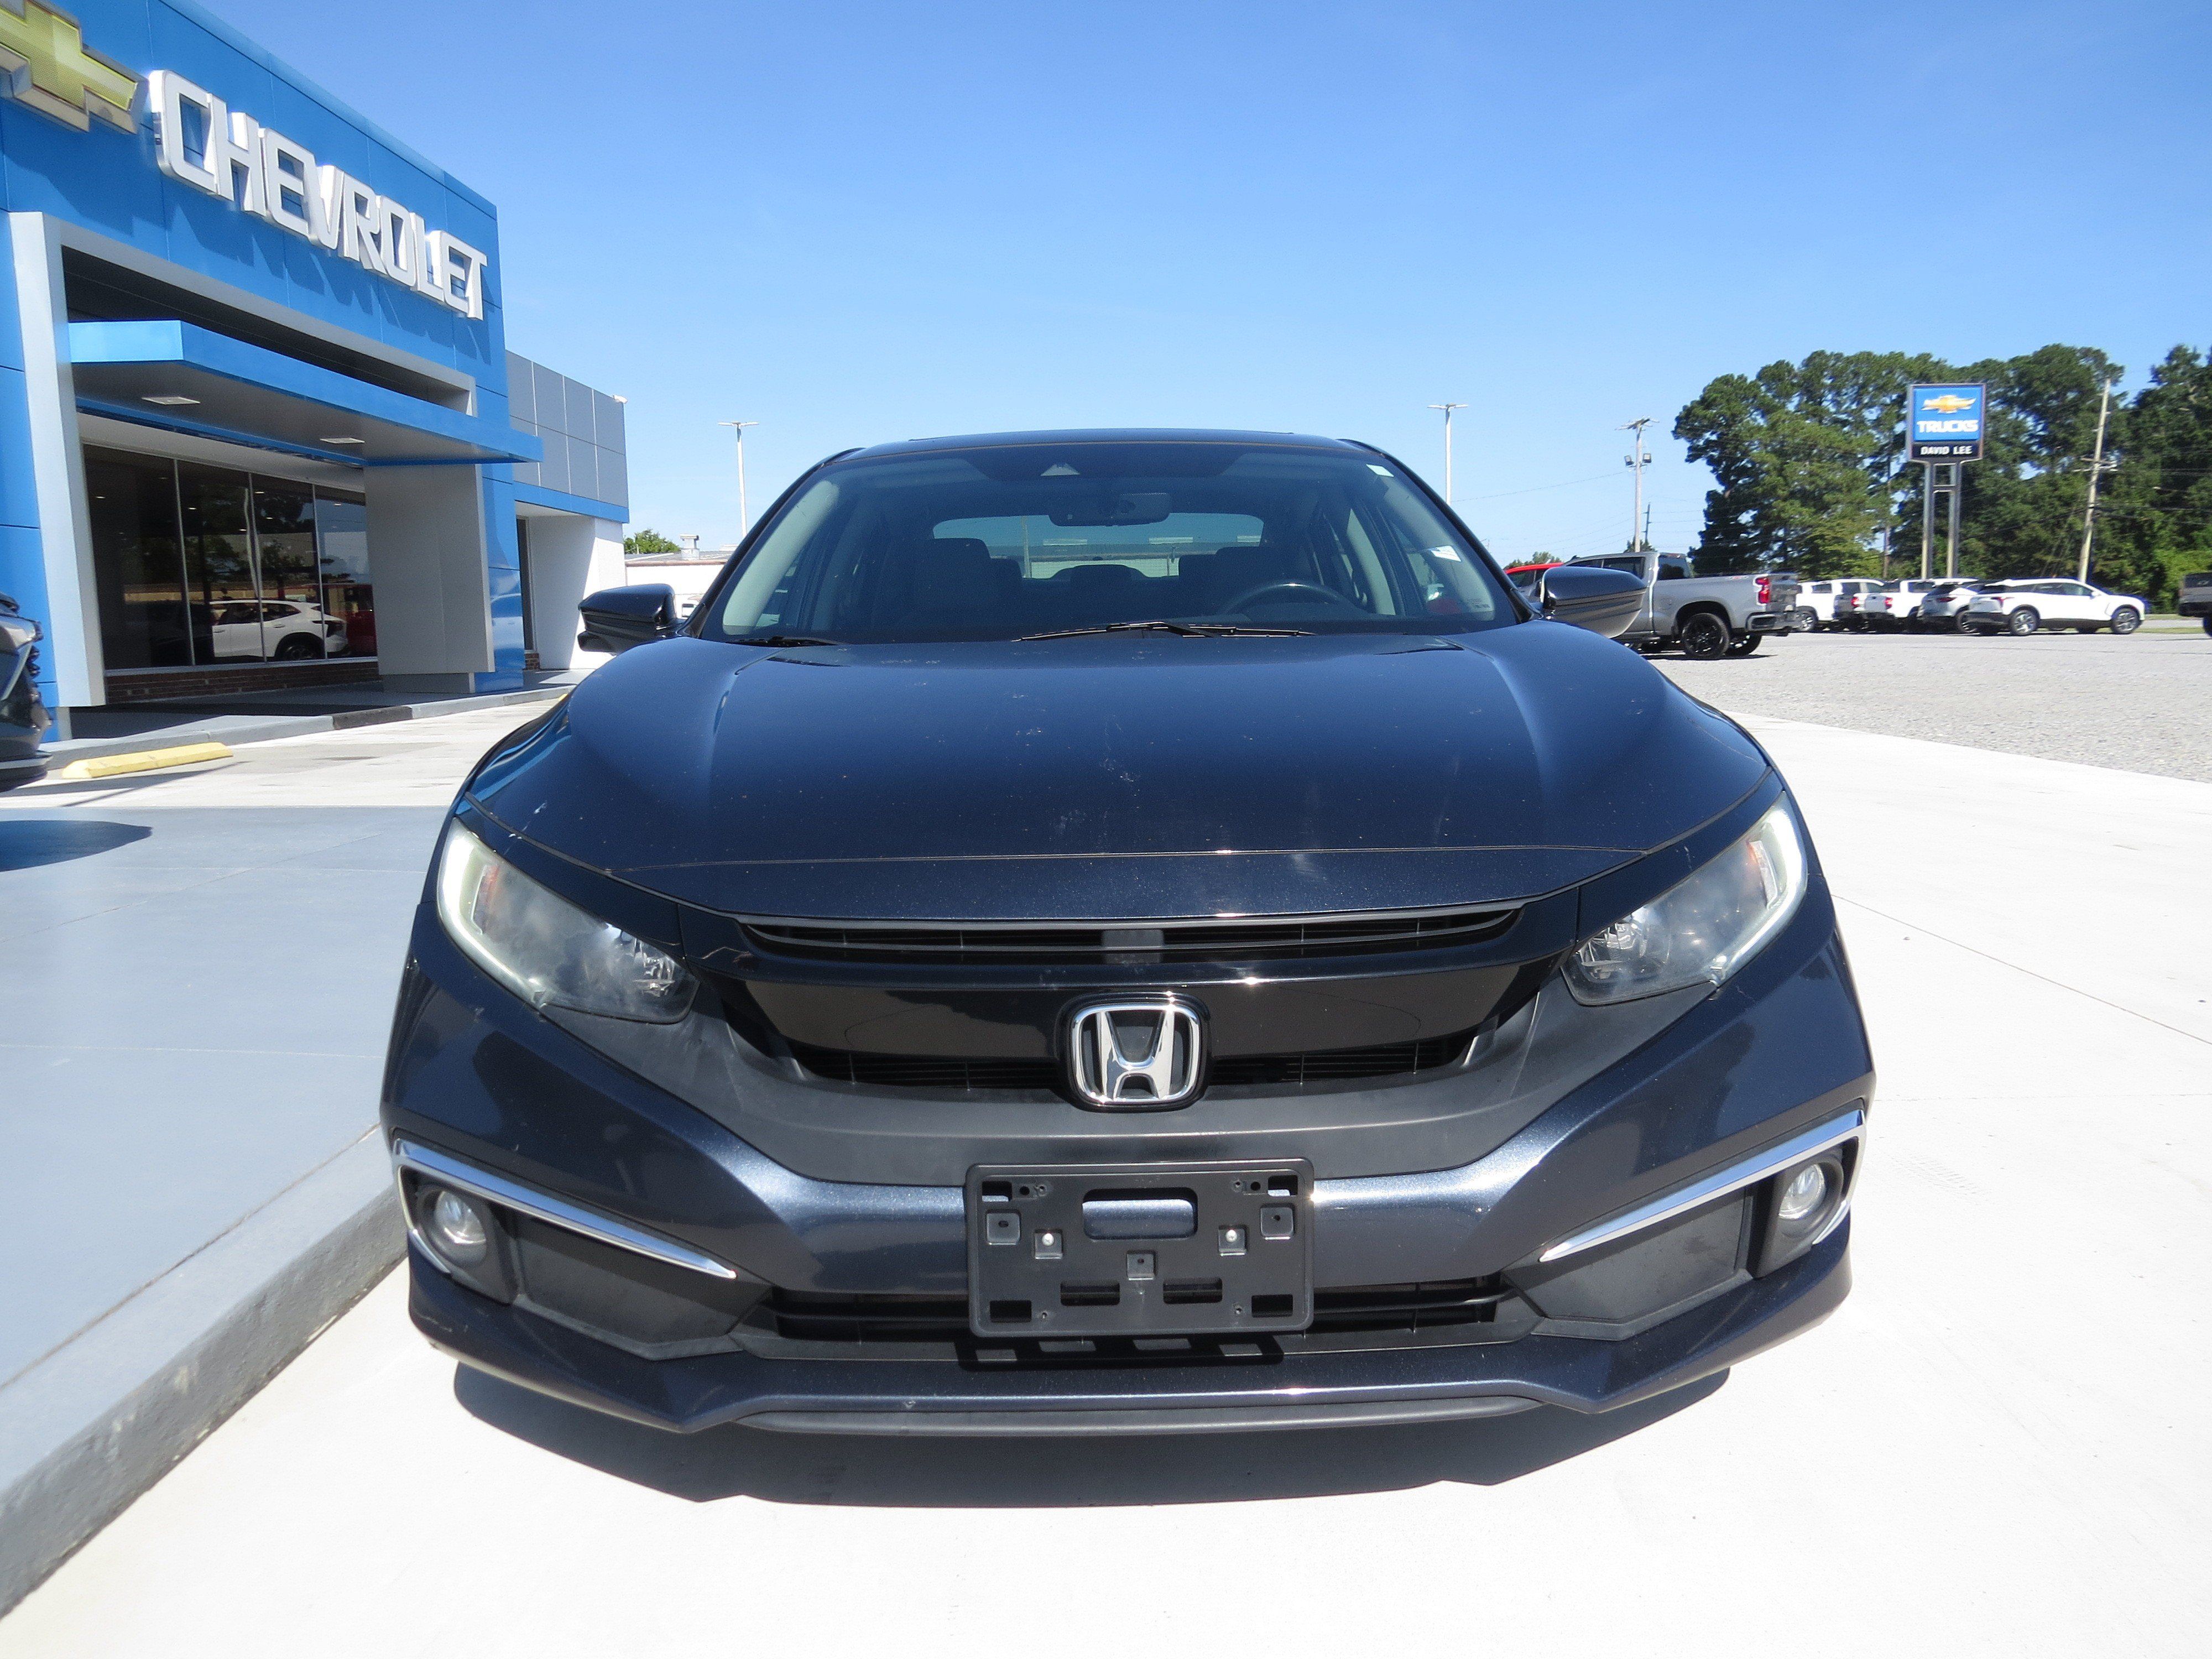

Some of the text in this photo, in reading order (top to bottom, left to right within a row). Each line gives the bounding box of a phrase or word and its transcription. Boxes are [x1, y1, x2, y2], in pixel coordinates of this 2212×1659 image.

[149, 70, 488, 321] CHEVROLET
[1917, 420, 1979, 432] TRUCKS
[1920, 445, 1973, 455] DAVID LEE
